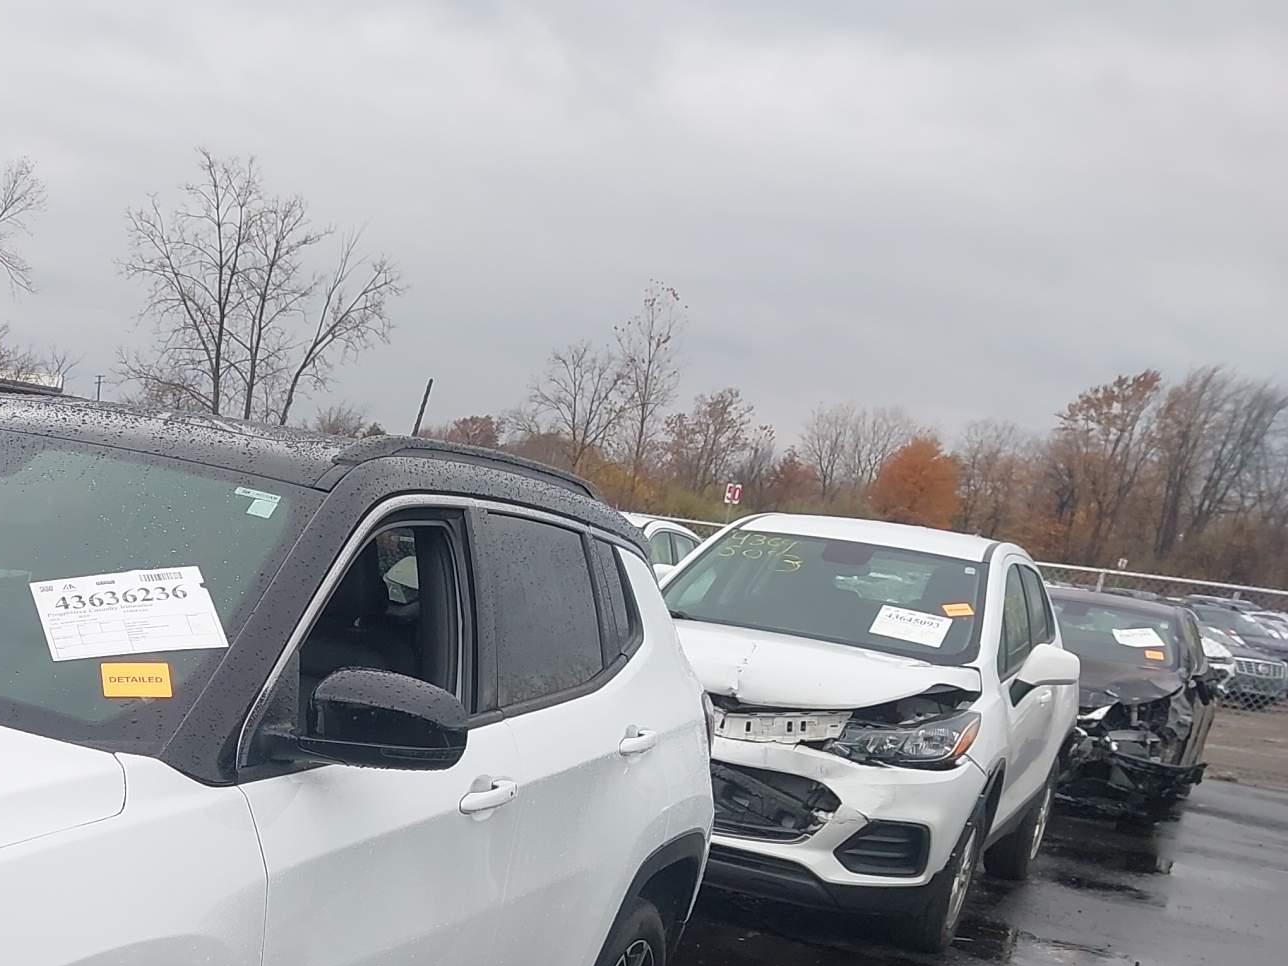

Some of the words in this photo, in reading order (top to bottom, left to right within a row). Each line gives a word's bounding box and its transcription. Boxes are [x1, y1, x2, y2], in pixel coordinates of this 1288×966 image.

[725, 485, 743, 503] 50
[55, 584, 188, 610] 43636236
[109, 676, 163, 684] DETAILED
